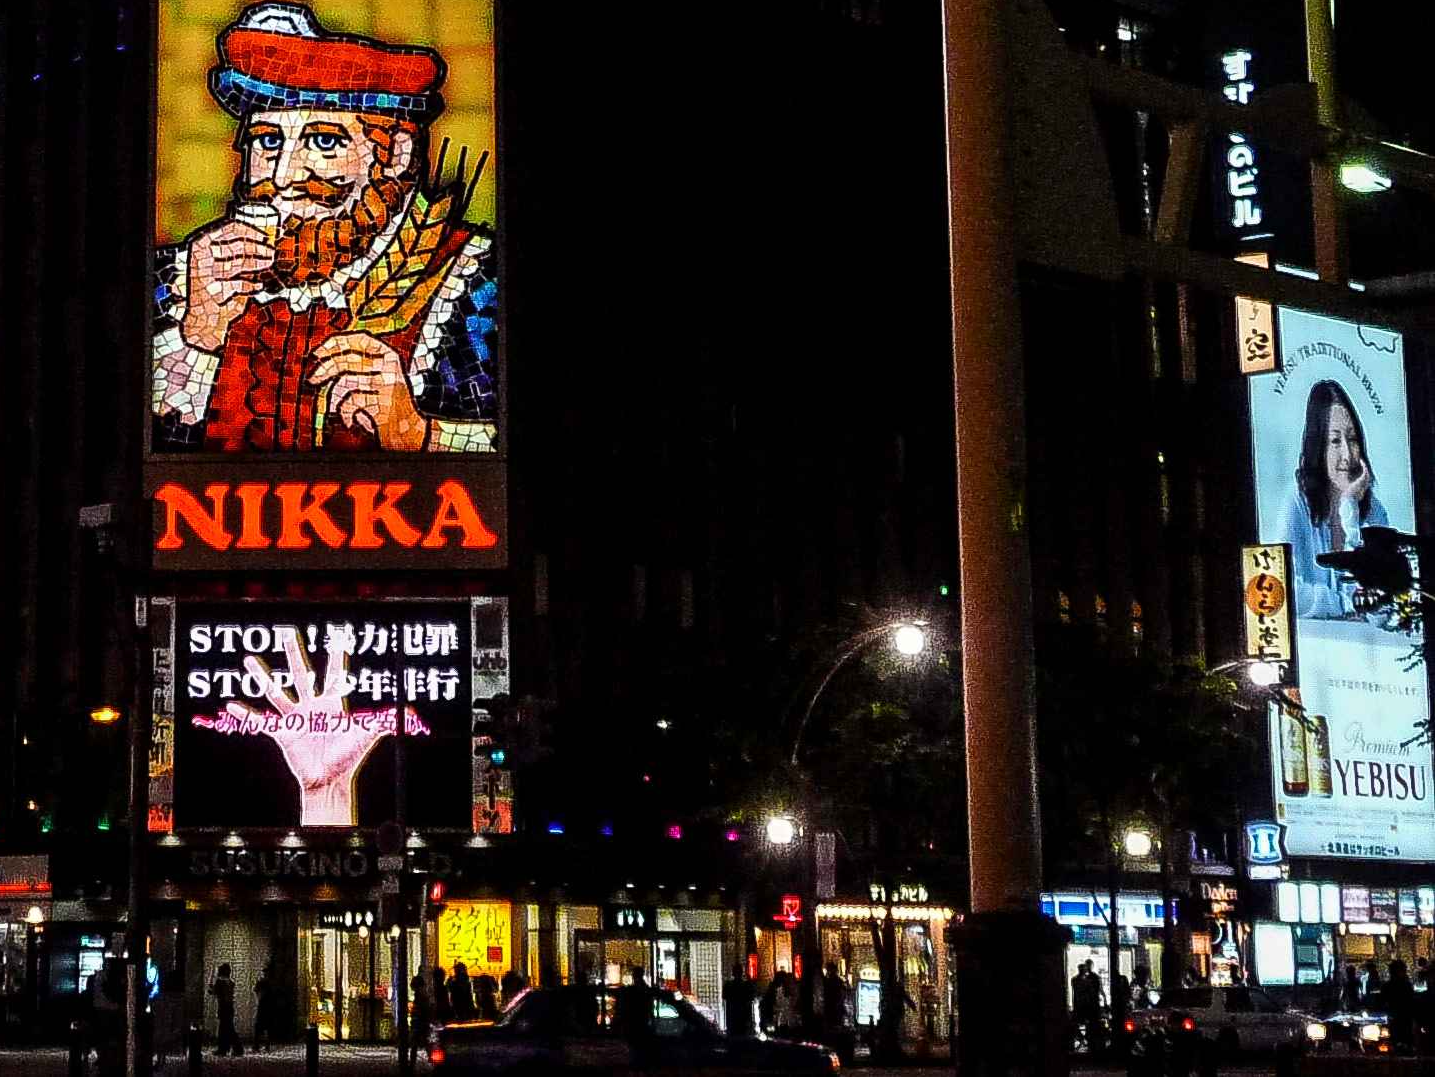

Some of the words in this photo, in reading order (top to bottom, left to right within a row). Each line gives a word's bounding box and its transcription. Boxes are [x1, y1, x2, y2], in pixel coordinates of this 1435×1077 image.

[1221, 48, 1263, 228] すすのビル
[153, 478, 499, 552] NIKKA
[1334, 758, 1426, 801] YEBISU
